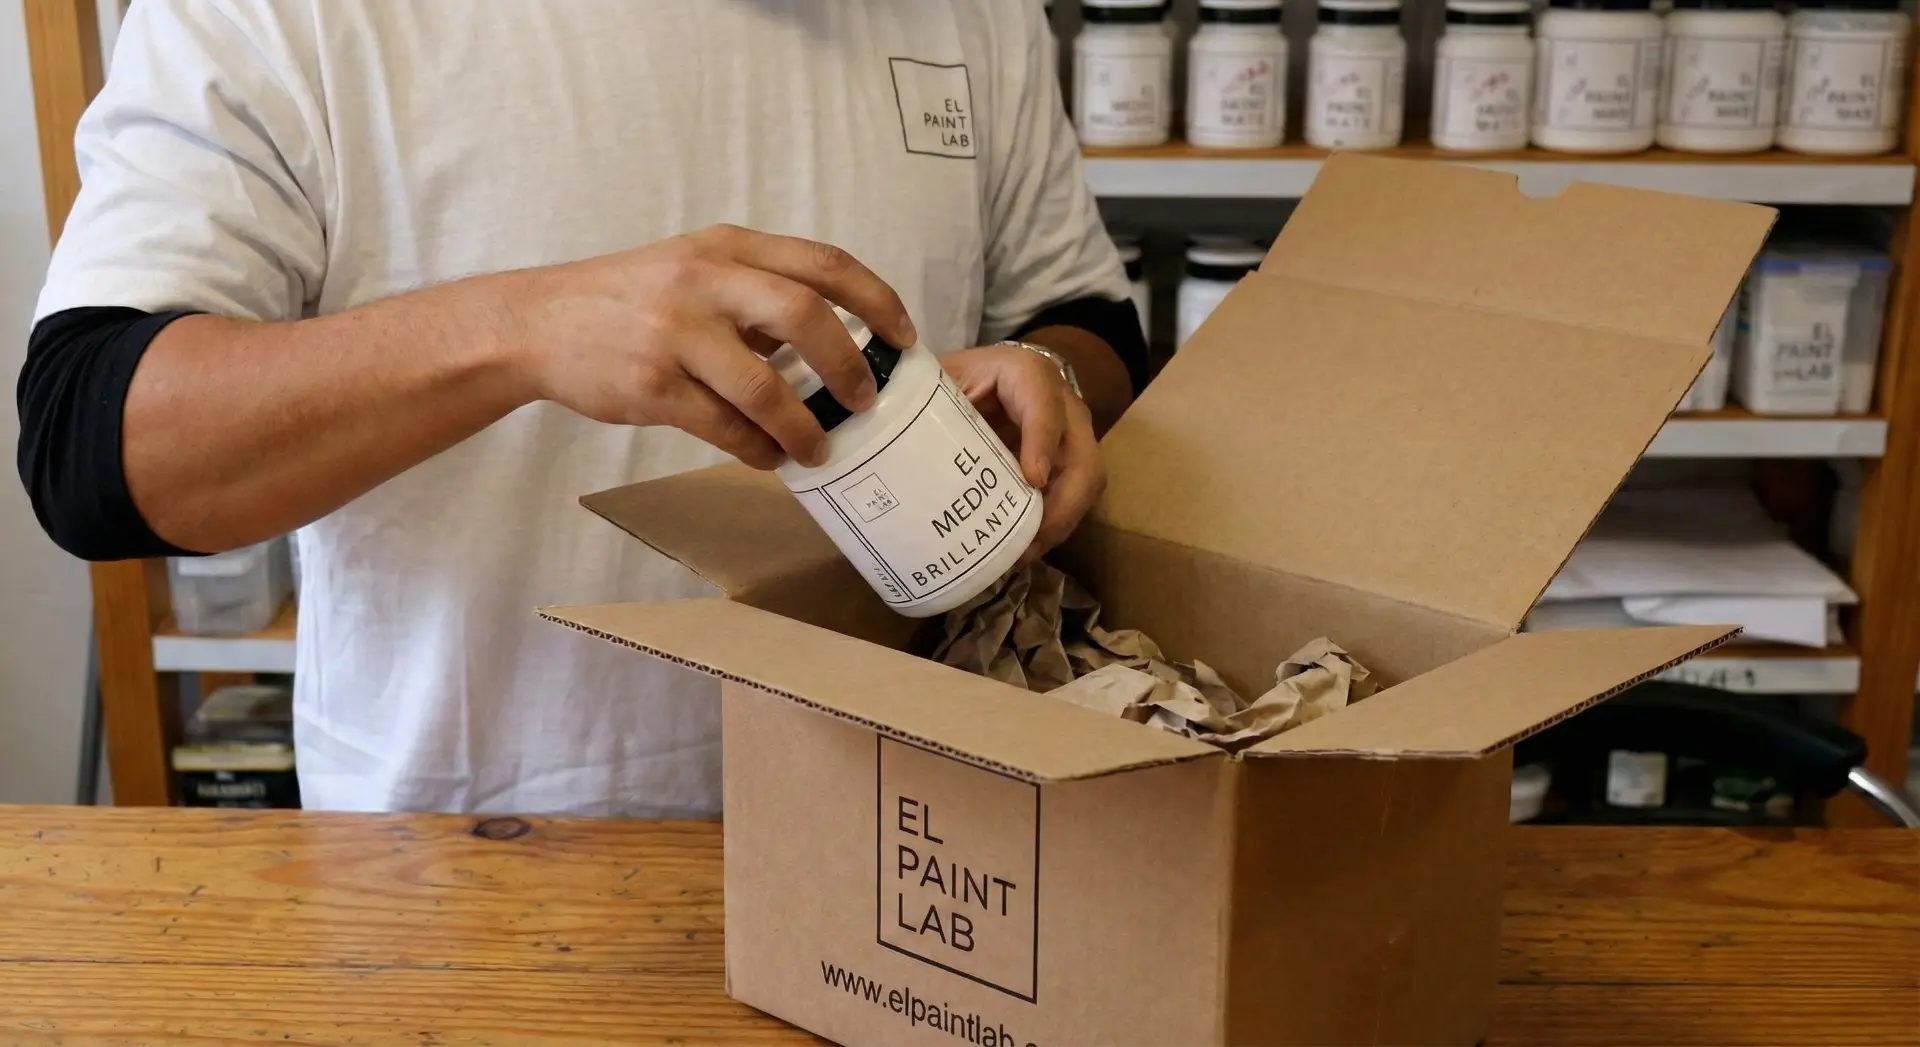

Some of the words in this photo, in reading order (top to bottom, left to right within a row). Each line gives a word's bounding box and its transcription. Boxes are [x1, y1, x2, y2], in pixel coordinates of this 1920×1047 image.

[924, 112, 967, 130] PAINT
[944, 98, 963, 113] EL
[941, 132, 970, 148] LAB
[953, 447, 981, 476] EL
[931, 467, 998, 538] MEDIO
[911, 490, 1018, 587] BRILLANTE
[898, 795, 944, 845] EL
[898, 844, 1017, 916] PAINT
[898, 892, 976, 952] LAB
